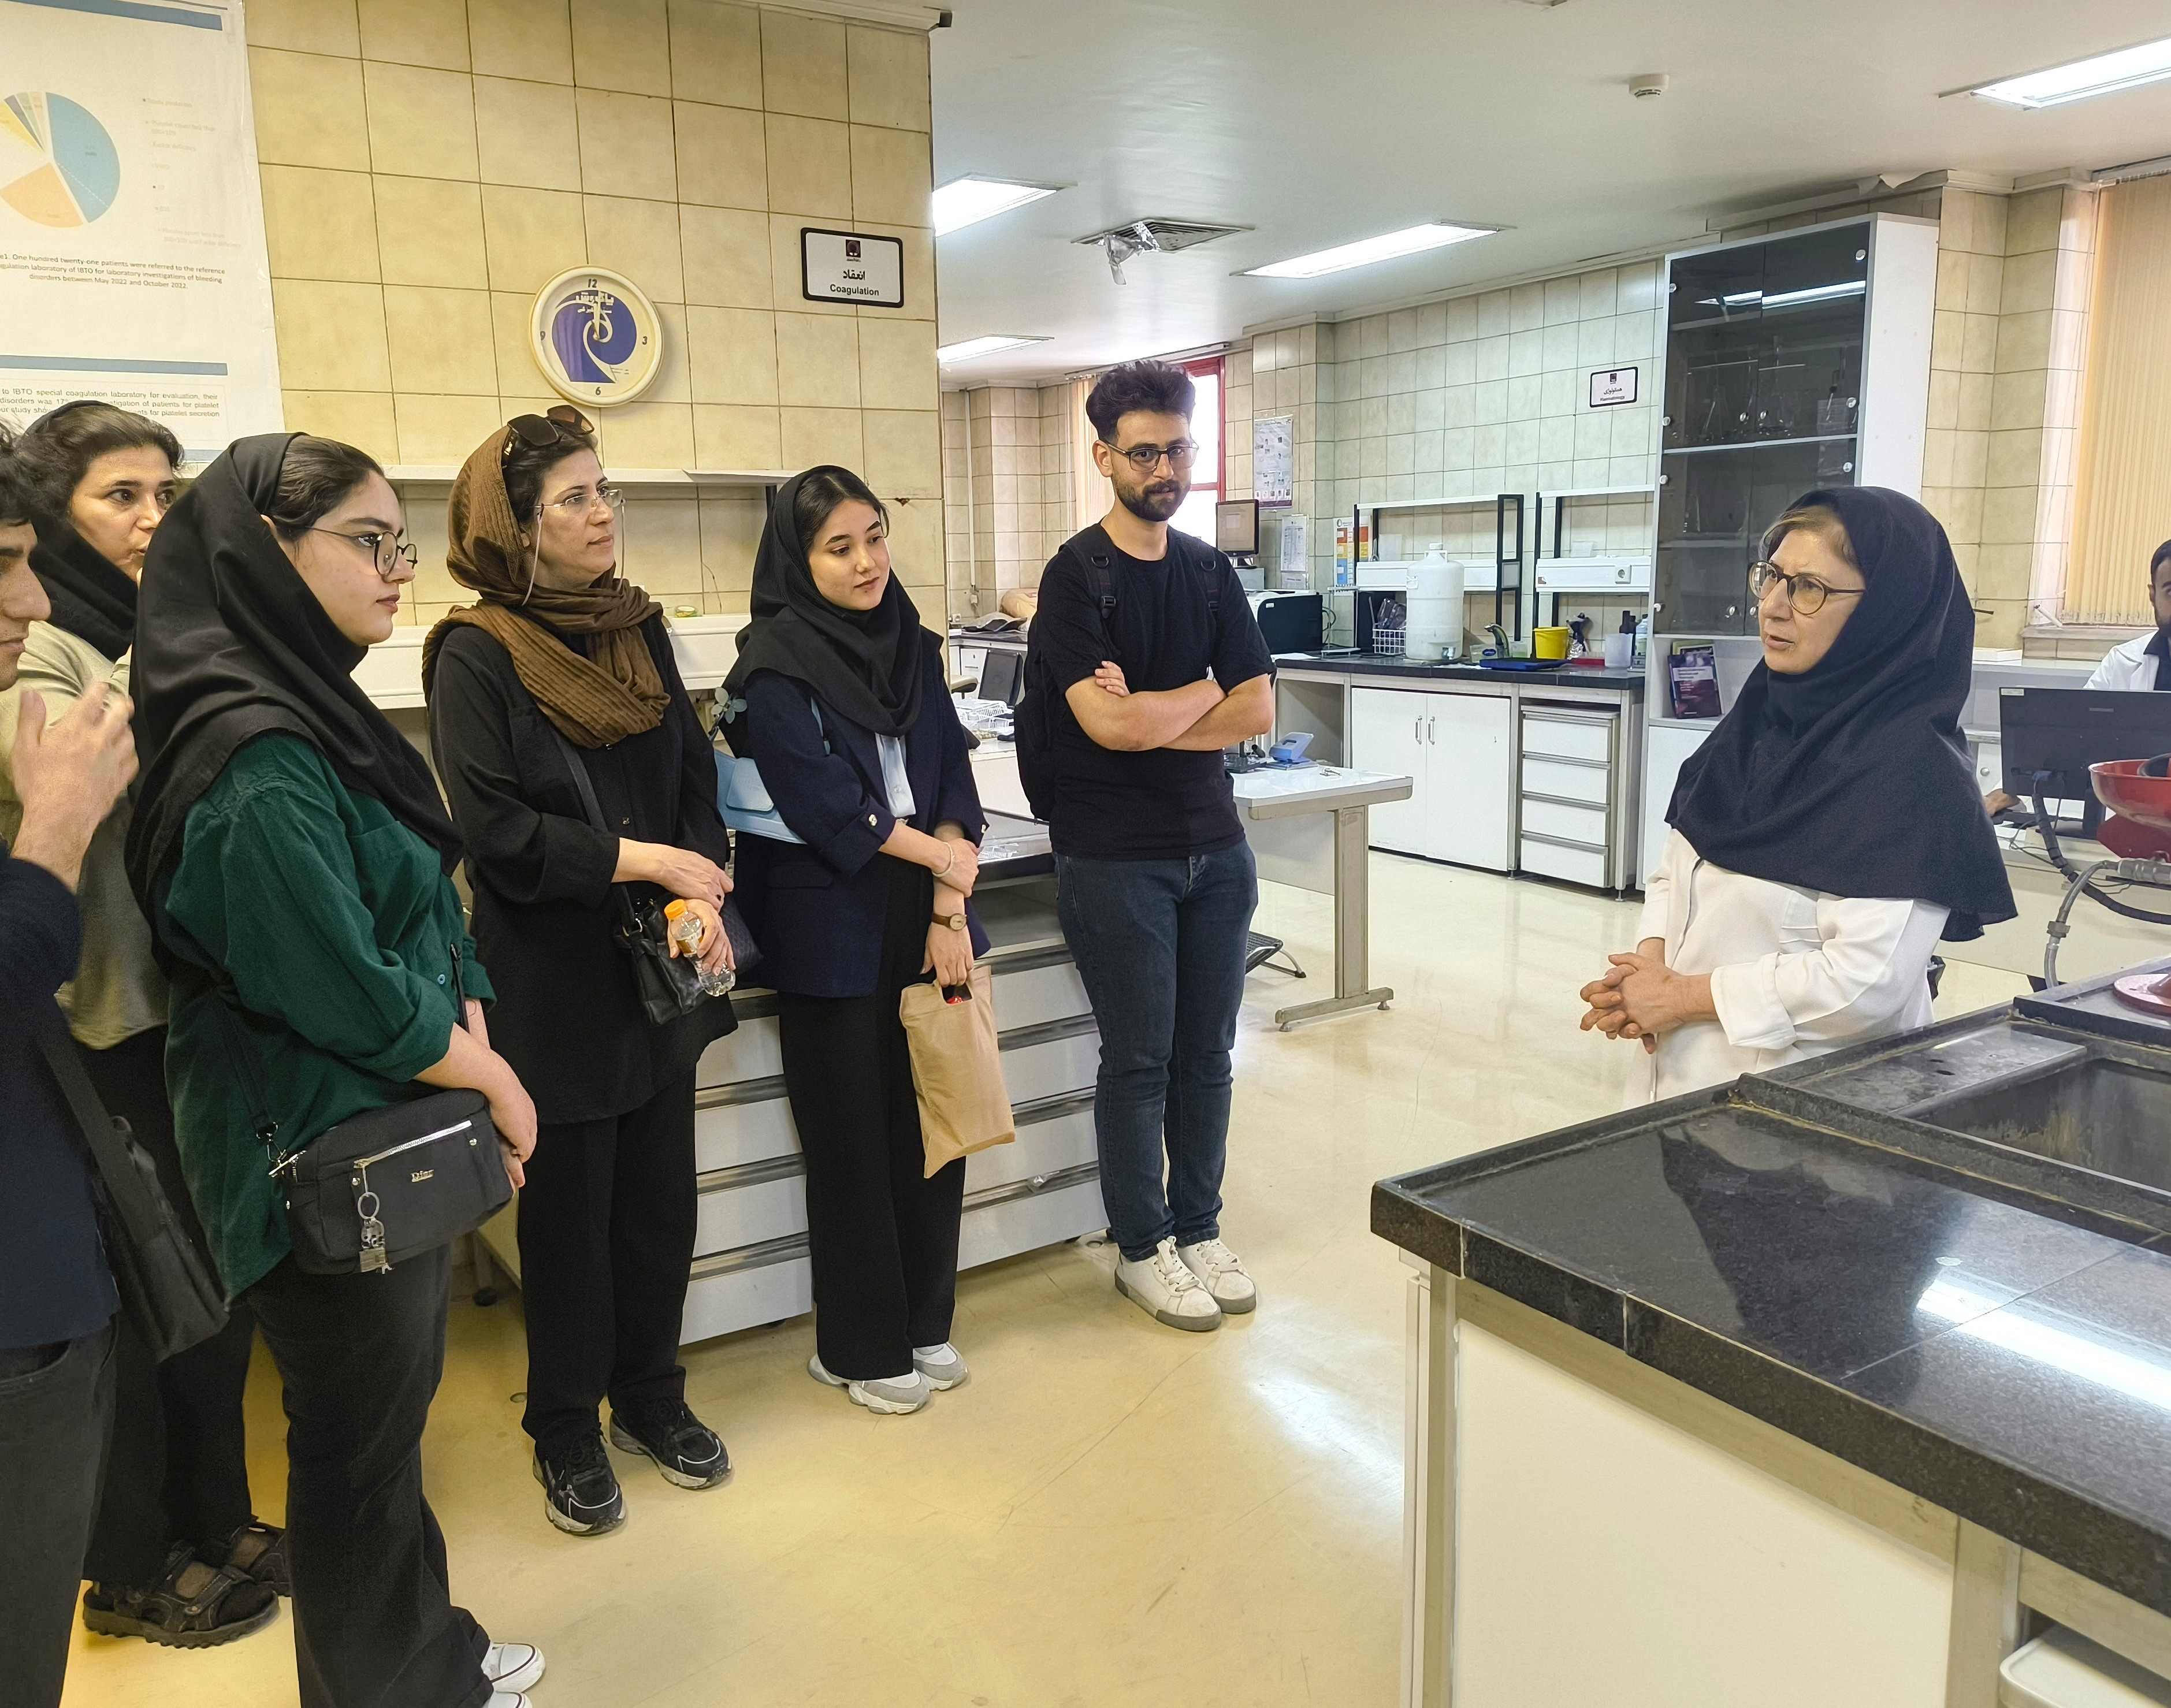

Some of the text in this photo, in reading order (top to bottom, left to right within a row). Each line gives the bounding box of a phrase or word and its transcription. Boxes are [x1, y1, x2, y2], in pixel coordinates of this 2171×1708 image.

[29, 255, 58, 263] hundred
[60, 258, 99, 266] twenty-one
[101, 259, 128, 267] patients
[31, 264, 66, 273] laboratory
[106, 269, 141, 277] laboratory
[143, 271, 186, 280] investigations
[195, 275, 222, 284] bleeding
[843, 269, 865, 280] انعقاد
[588, 278, 597, 288] 12
[830, 284, 879, 296] Coagulation
[540, 330, 546, 341] 9
[642, 336, 648, 345] 3
[595, 386, 601, 396] 6
